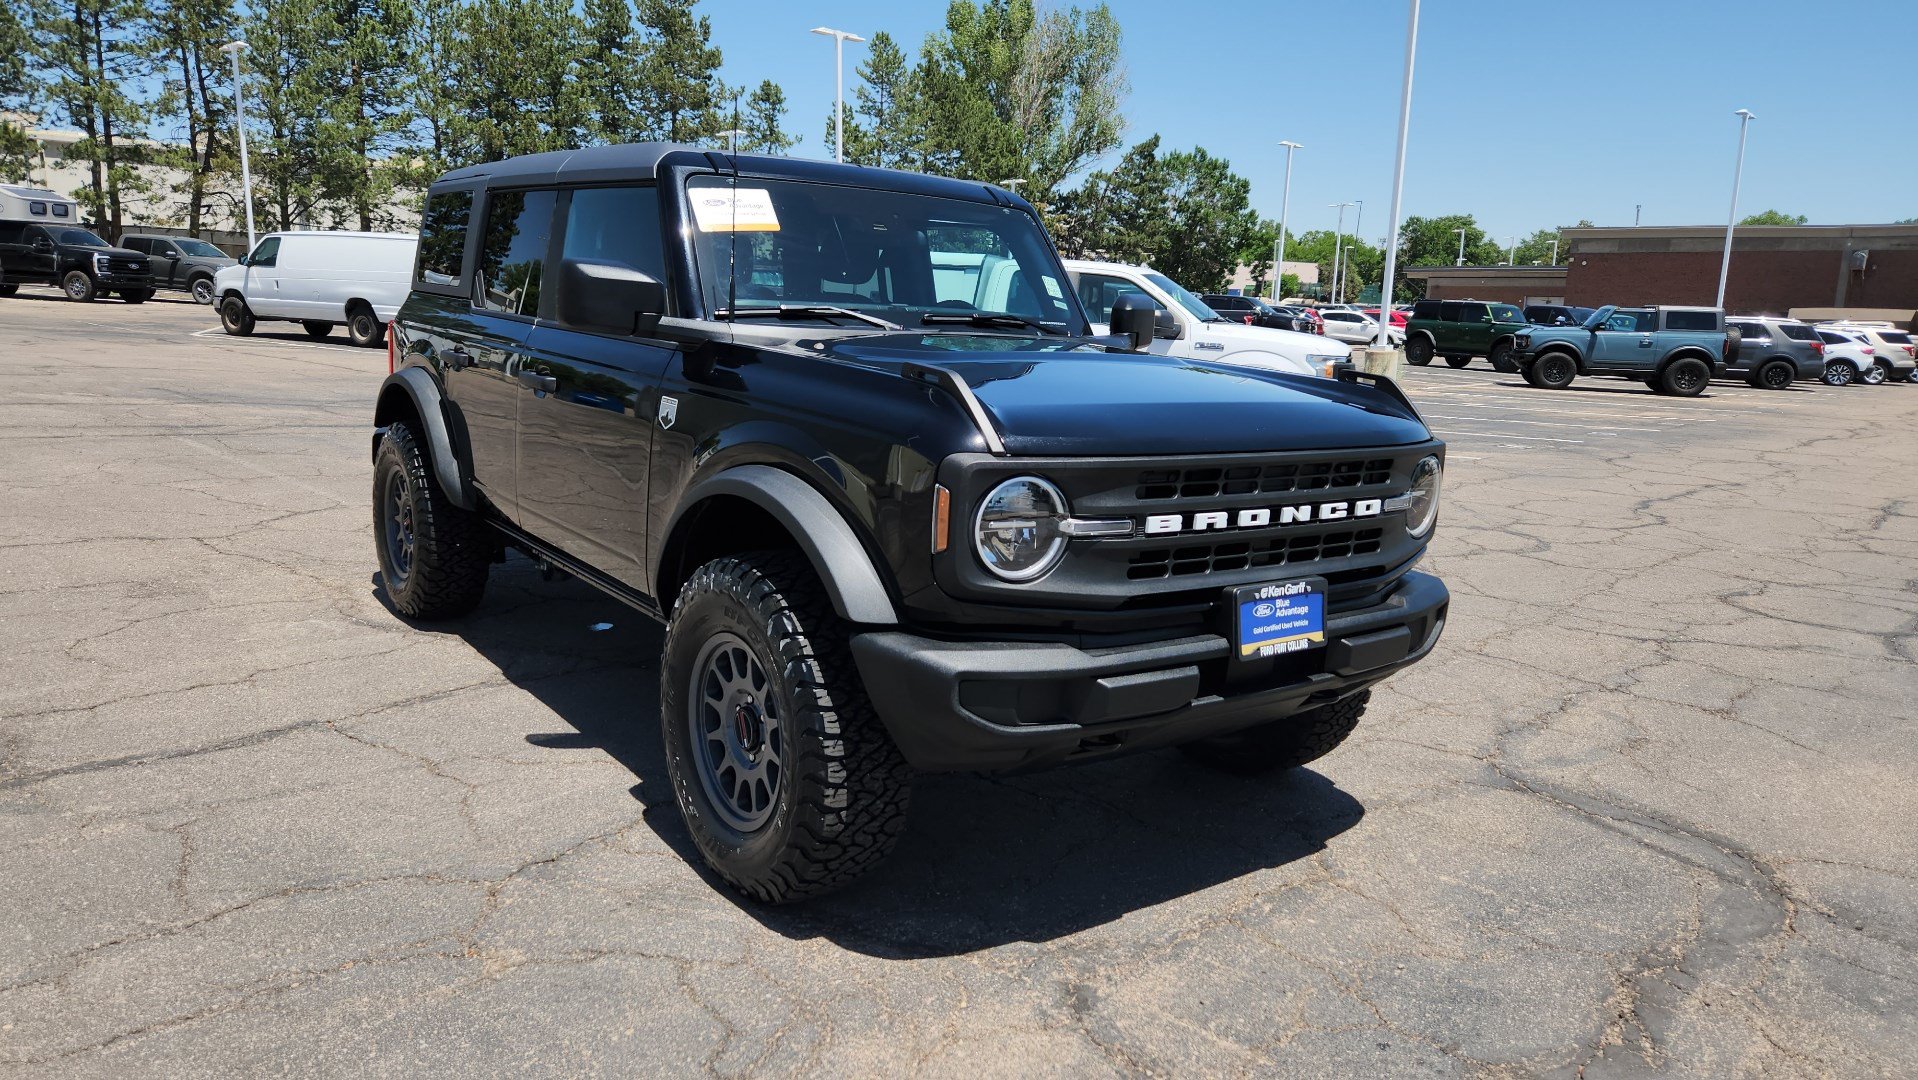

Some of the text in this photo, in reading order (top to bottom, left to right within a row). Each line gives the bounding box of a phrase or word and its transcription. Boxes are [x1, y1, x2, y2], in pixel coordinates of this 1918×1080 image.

[1144, 499, 1381, 534] BRONCO
[1275, 599, 1290, 608] Blue
[1275, 605, 1309, 617] Advantage
[1253, 619, 1309, 635] Gold Certified Used Vehicle
[1260, 638, 1309, 657] FORD FORT COLLINS
